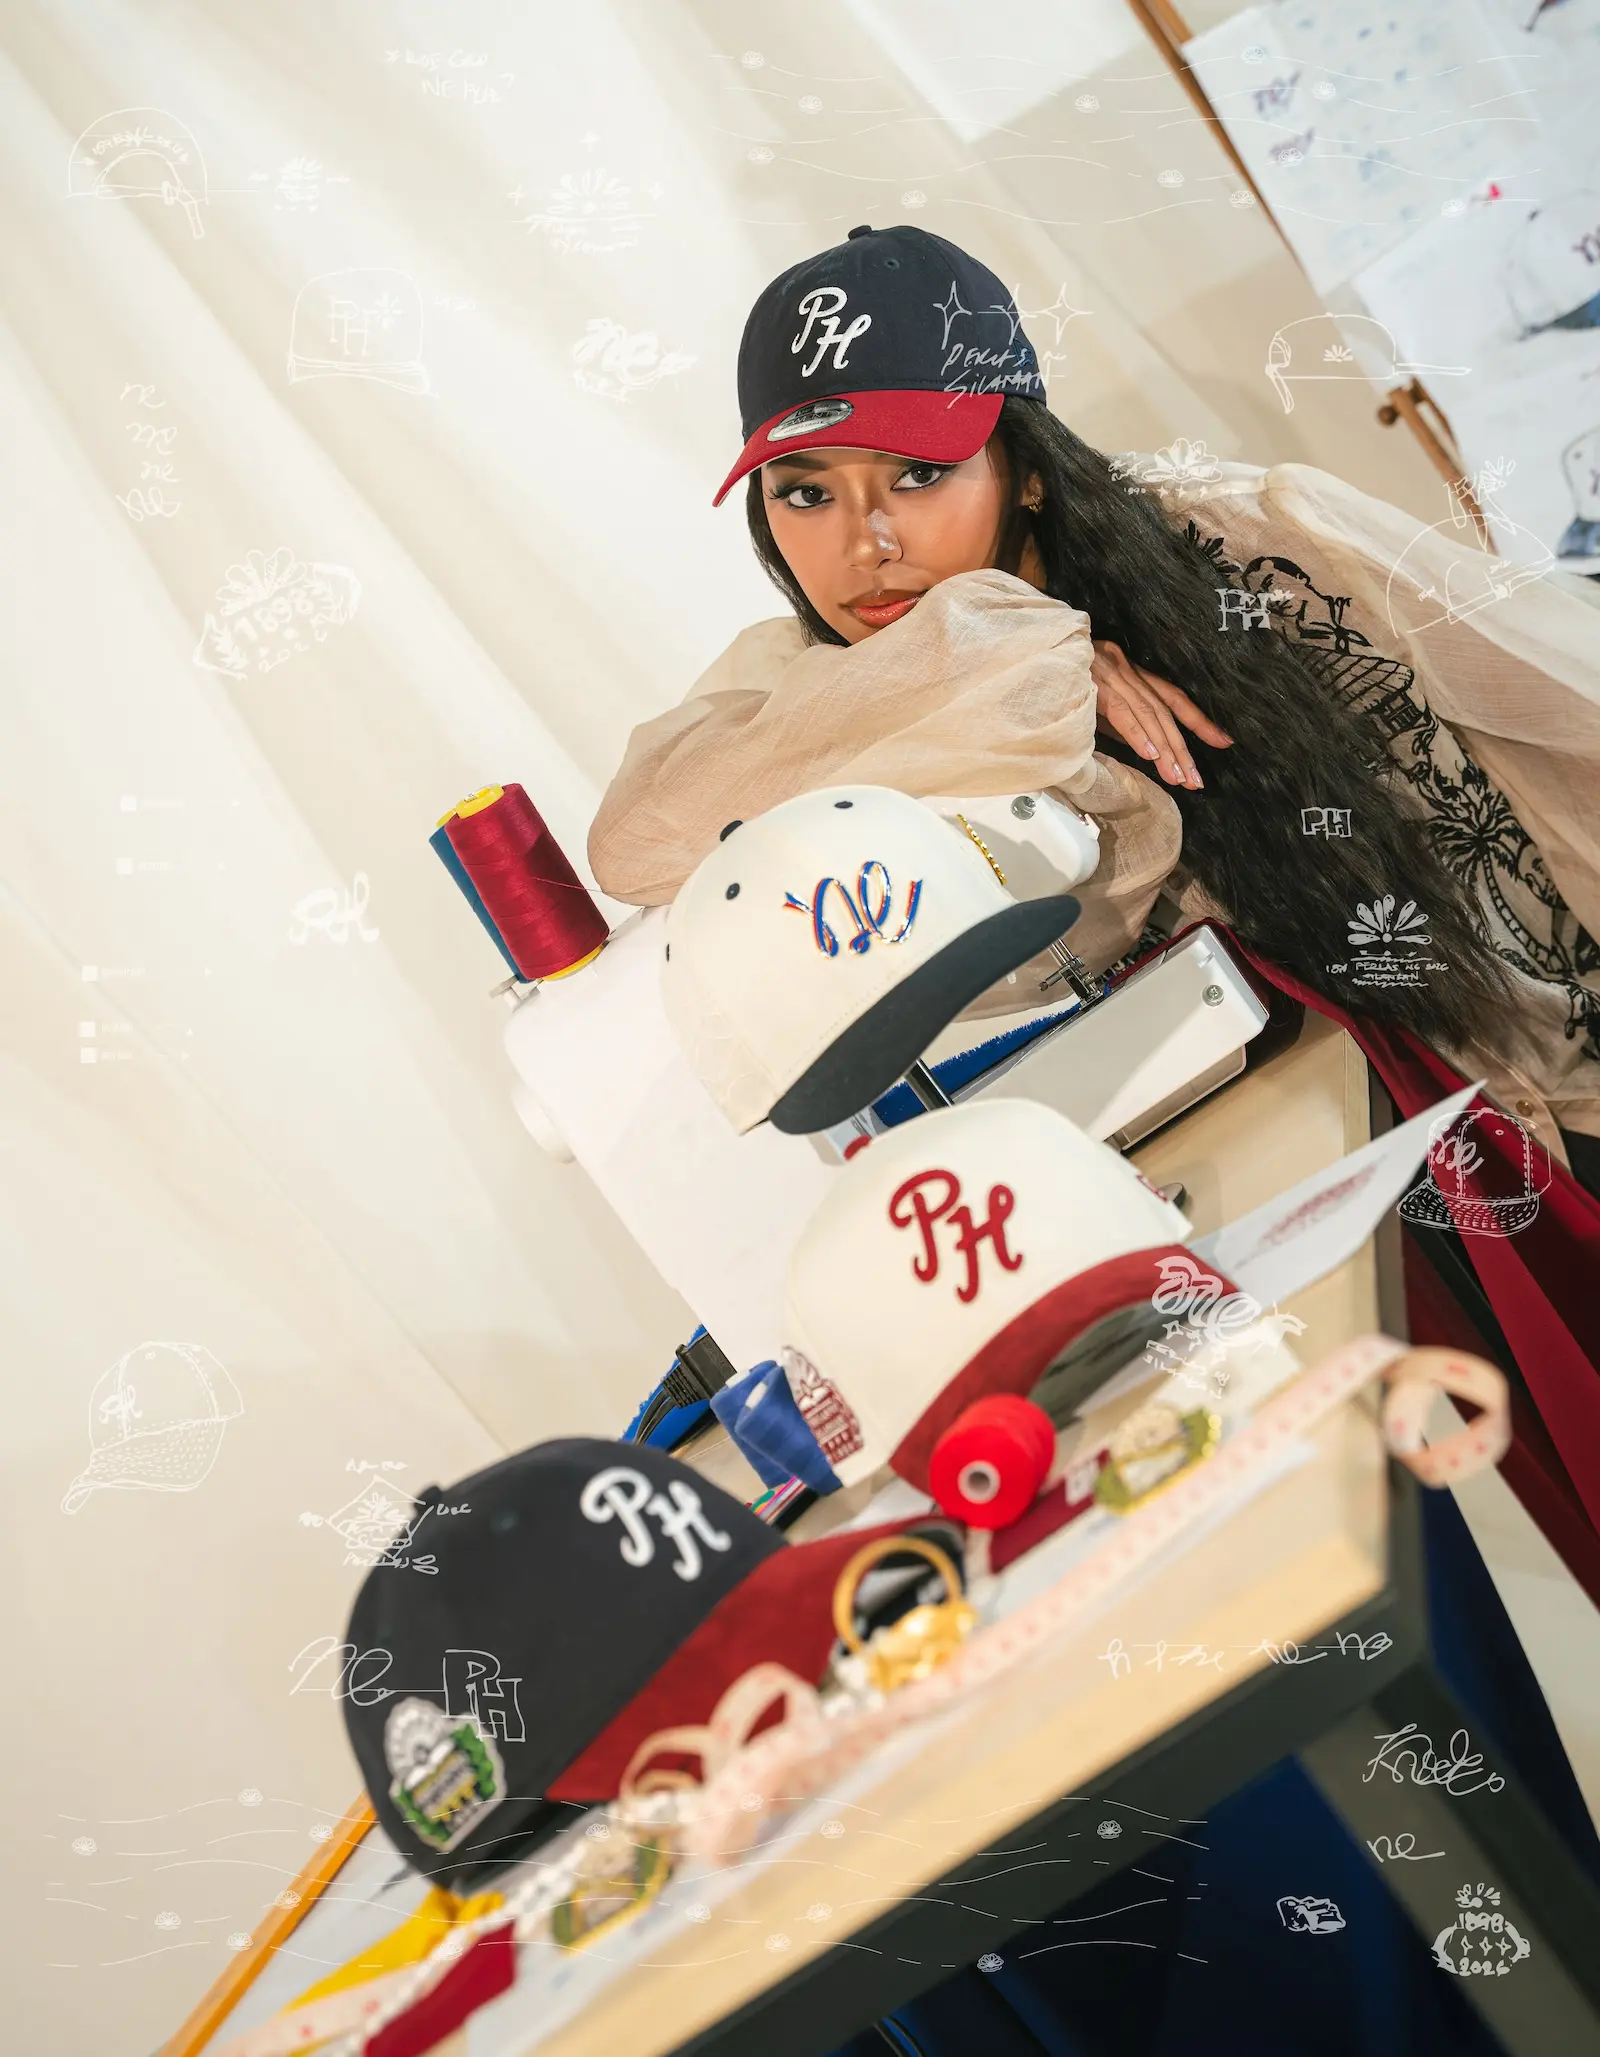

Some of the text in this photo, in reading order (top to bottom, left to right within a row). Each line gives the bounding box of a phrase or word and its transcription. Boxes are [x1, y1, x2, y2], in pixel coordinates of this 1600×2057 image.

[791, 287, 872, 377] PH
[889, 1169, 1023, 1303] PH
[580, 1465, 732, 1582] PH
